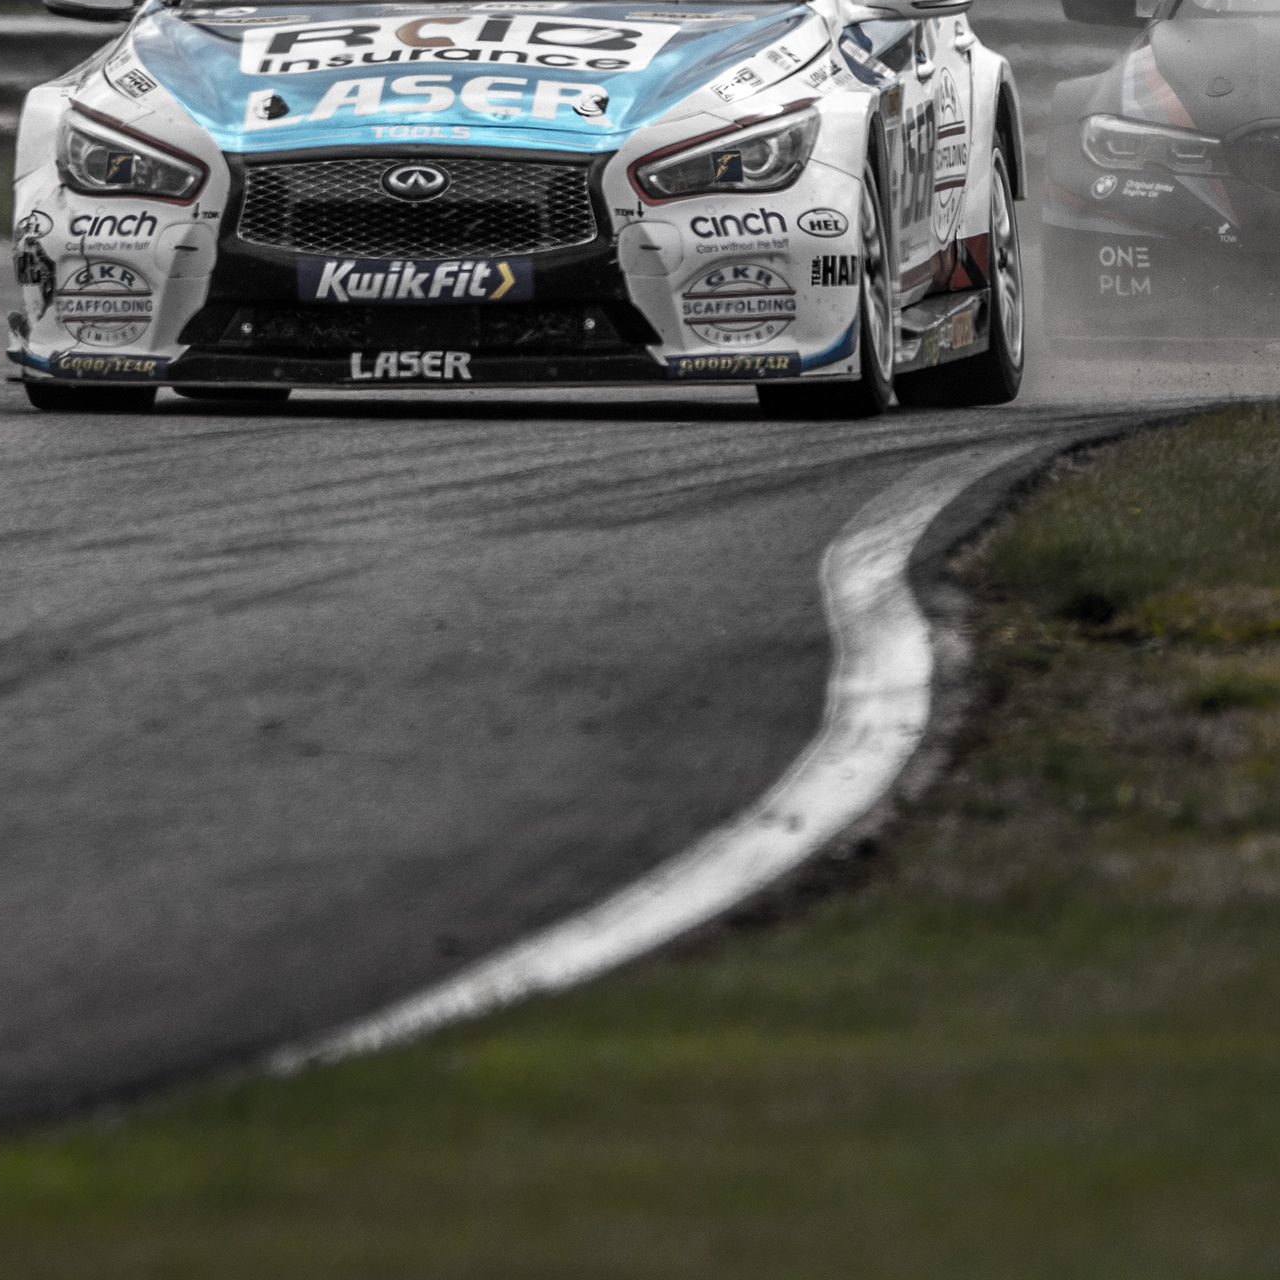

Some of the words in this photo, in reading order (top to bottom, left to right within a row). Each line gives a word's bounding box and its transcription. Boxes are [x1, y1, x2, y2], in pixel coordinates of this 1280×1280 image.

[243, 74, 614, 132] LASER
[370, 125, 473, 140] TOOLS
[69, 210, 158, 237] cinch
[689, 207, 788, 239] cinch
[808, 218, 843, 232] HEL
[1219, 234, 1238, 243] TOW
[1099, 245, 1151, 269] ONE
[73, 265, 137, 288] GKR
[705, 267, 774, 287] GKR
[1099, 274, 1152, 295] PLM
[682, 297, 797, 316] SCAFFOLDING
[349, 350, 473, 380] LASER
[679, 354, 790, 372] GOODYEAR
